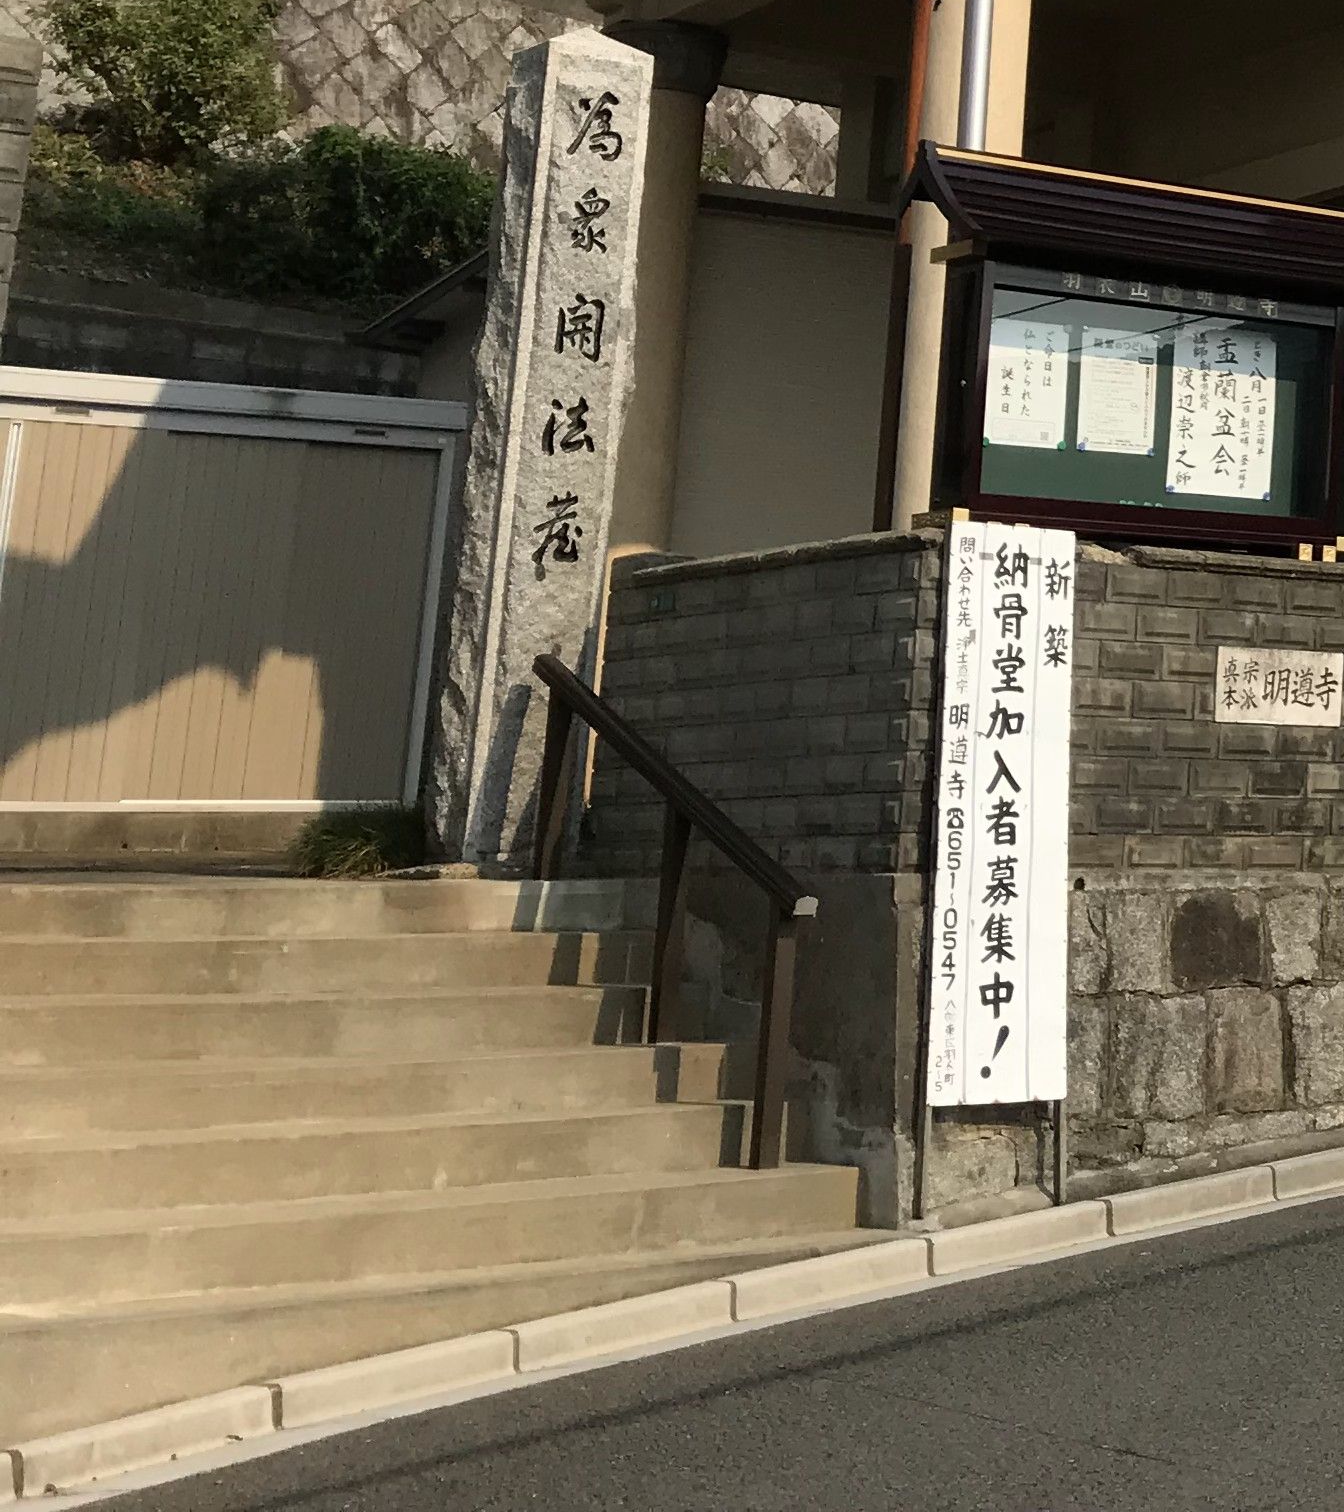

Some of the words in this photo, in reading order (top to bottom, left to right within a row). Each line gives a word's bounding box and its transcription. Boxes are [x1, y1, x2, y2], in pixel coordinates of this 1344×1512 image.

[1001, 366, 1014, 414] 誕生日
[1210, 337, 1239, 477] 盂蘭盆会
[956, 536, 977, 628] 問い合わせ先
[1042, 557, 1072, 669] 新築
